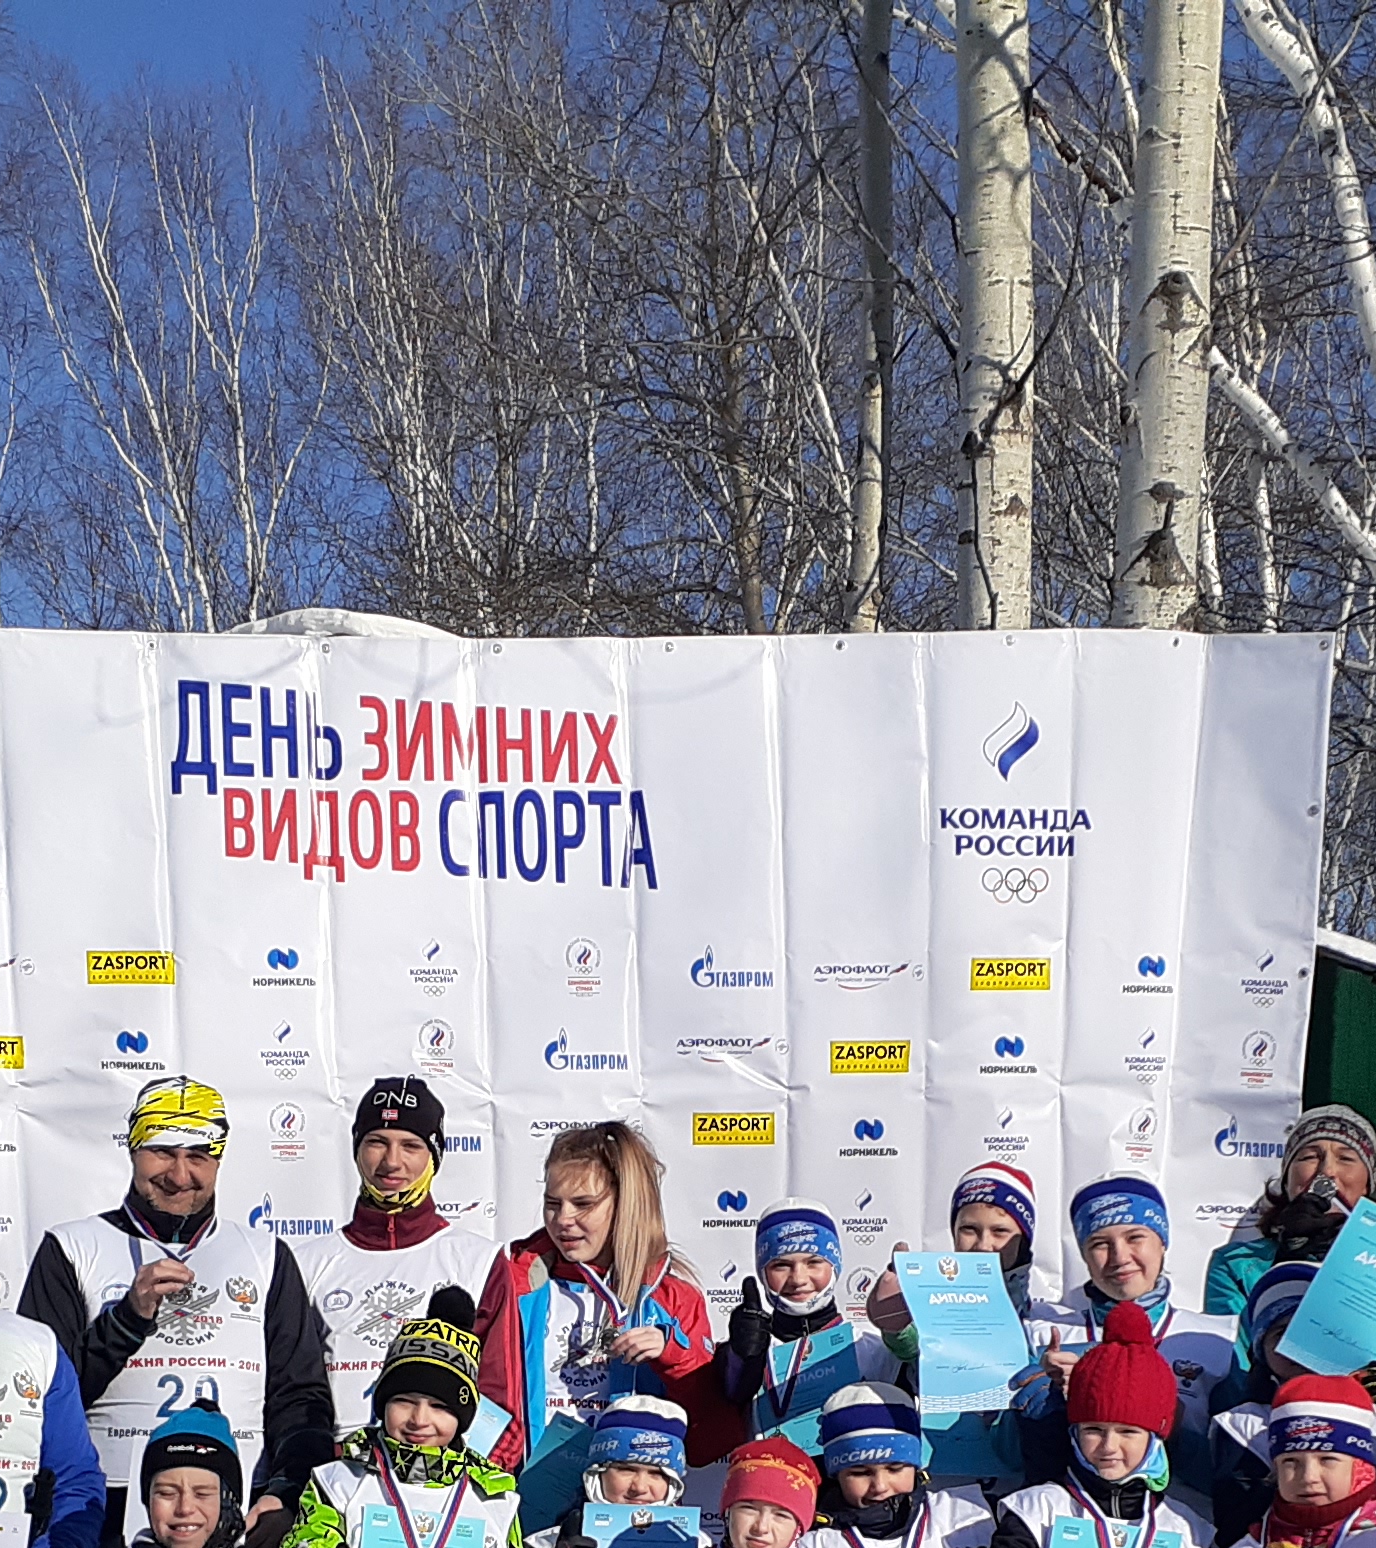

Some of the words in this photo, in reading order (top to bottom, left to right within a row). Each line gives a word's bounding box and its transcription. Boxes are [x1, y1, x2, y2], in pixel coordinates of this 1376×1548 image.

[171, 679, 344, 795] ДЕНЬ
[359, 695, 623, 784] ЗИМНИХ
[939, 807, 1092, 833] КОМАНДА
[224, 787, 421, 883] ВИДОВ
[438, 788, 659, 891] СПОРТА
[954, 834, 1076, 858] РОССИИ
[91, 955, 170, 971] ZASPORT
[814, 965, 891, 975] АЭРОФЛОТ
[975, 963, 1046, 977] ZASPORT
[252, 977, 316, 987] НОРНИКЕЛЬ
[676, 1038, 753, 1048] АЭРОФЛОТ
[260, 1051, 310, 1059] КОМАНДА
[835, 1045, 907, 1060] ZASPORT
[101, 1061, 166, 1071] НОРНИКЕЛЬ
[265, 1058, 306, 1067] РОССИИ
[373, 1086, 418, 1108] DNB
[697, 1117, 770, 1132] ZASPORT
[444, 1136, 482, 1152] ПРОМ
[839, 1148, 899, 1157] НОРНИКЕЛЬ
[842, 1218, 888, 1226] КОМАНДА
[1090, 1214, 1134, 1229] 2019
[846, 1225, 884, 1233] РОССИИ
[777, 1243, 819, 1254] 2019
[364, 1280, 417, 1297] ЛЫЖНЯ
[929, 1292, 989, 1306] ДИПЛОМ
[193, 1315, 224, 1324] 2018
[156, 1331, 215, 1346] РОССИИ
[125, 1357, 164, 1368] ЖНЯ
[168, 1357, 227, 1368] РОССИИ
[325, 1361, 368, 1371] ЛЫЖНЯ
[559, 1371, 607, 1387] РОССИИ
[796, 1365, 836, 1383] ПЛОМ
[1284, 1441, 1335, 1451] 2018
[626, 1452, 671, 1466] 2019
